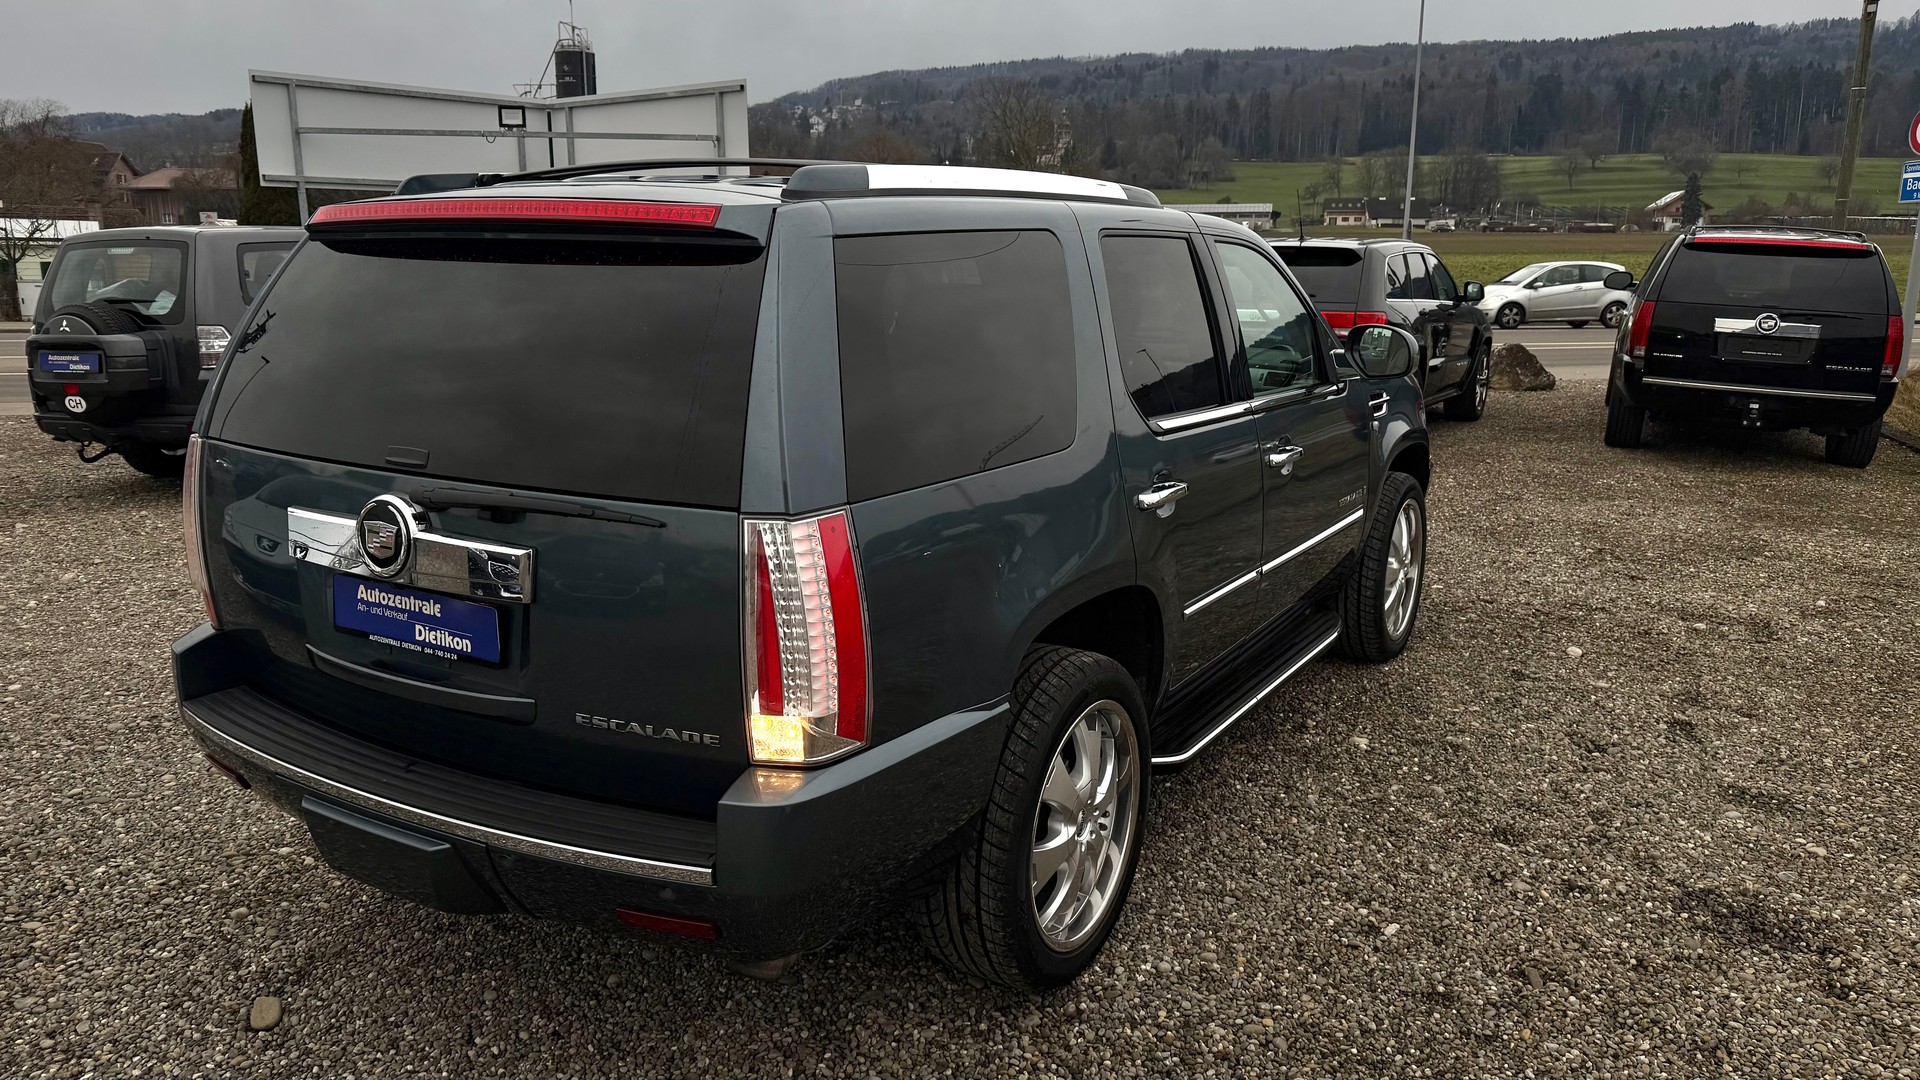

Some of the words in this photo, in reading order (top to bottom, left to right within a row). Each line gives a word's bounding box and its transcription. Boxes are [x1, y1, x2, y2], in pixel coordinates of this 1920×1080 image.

[68, 398, 83, 409] CH
[357, 584, 441, 617] Autozentrale
[357, 602, 369, 612] An-
[370, 606, 383, 615] und
[383, 608, 408, 621] Verkauf
[369, 634, 400, 647] AUTOZENTRALE
[402, 641, 422, 652] DIETIKON
[414, 624, 472, 653] Dietikon
[575, 712, 720, 747] ESCALADE
